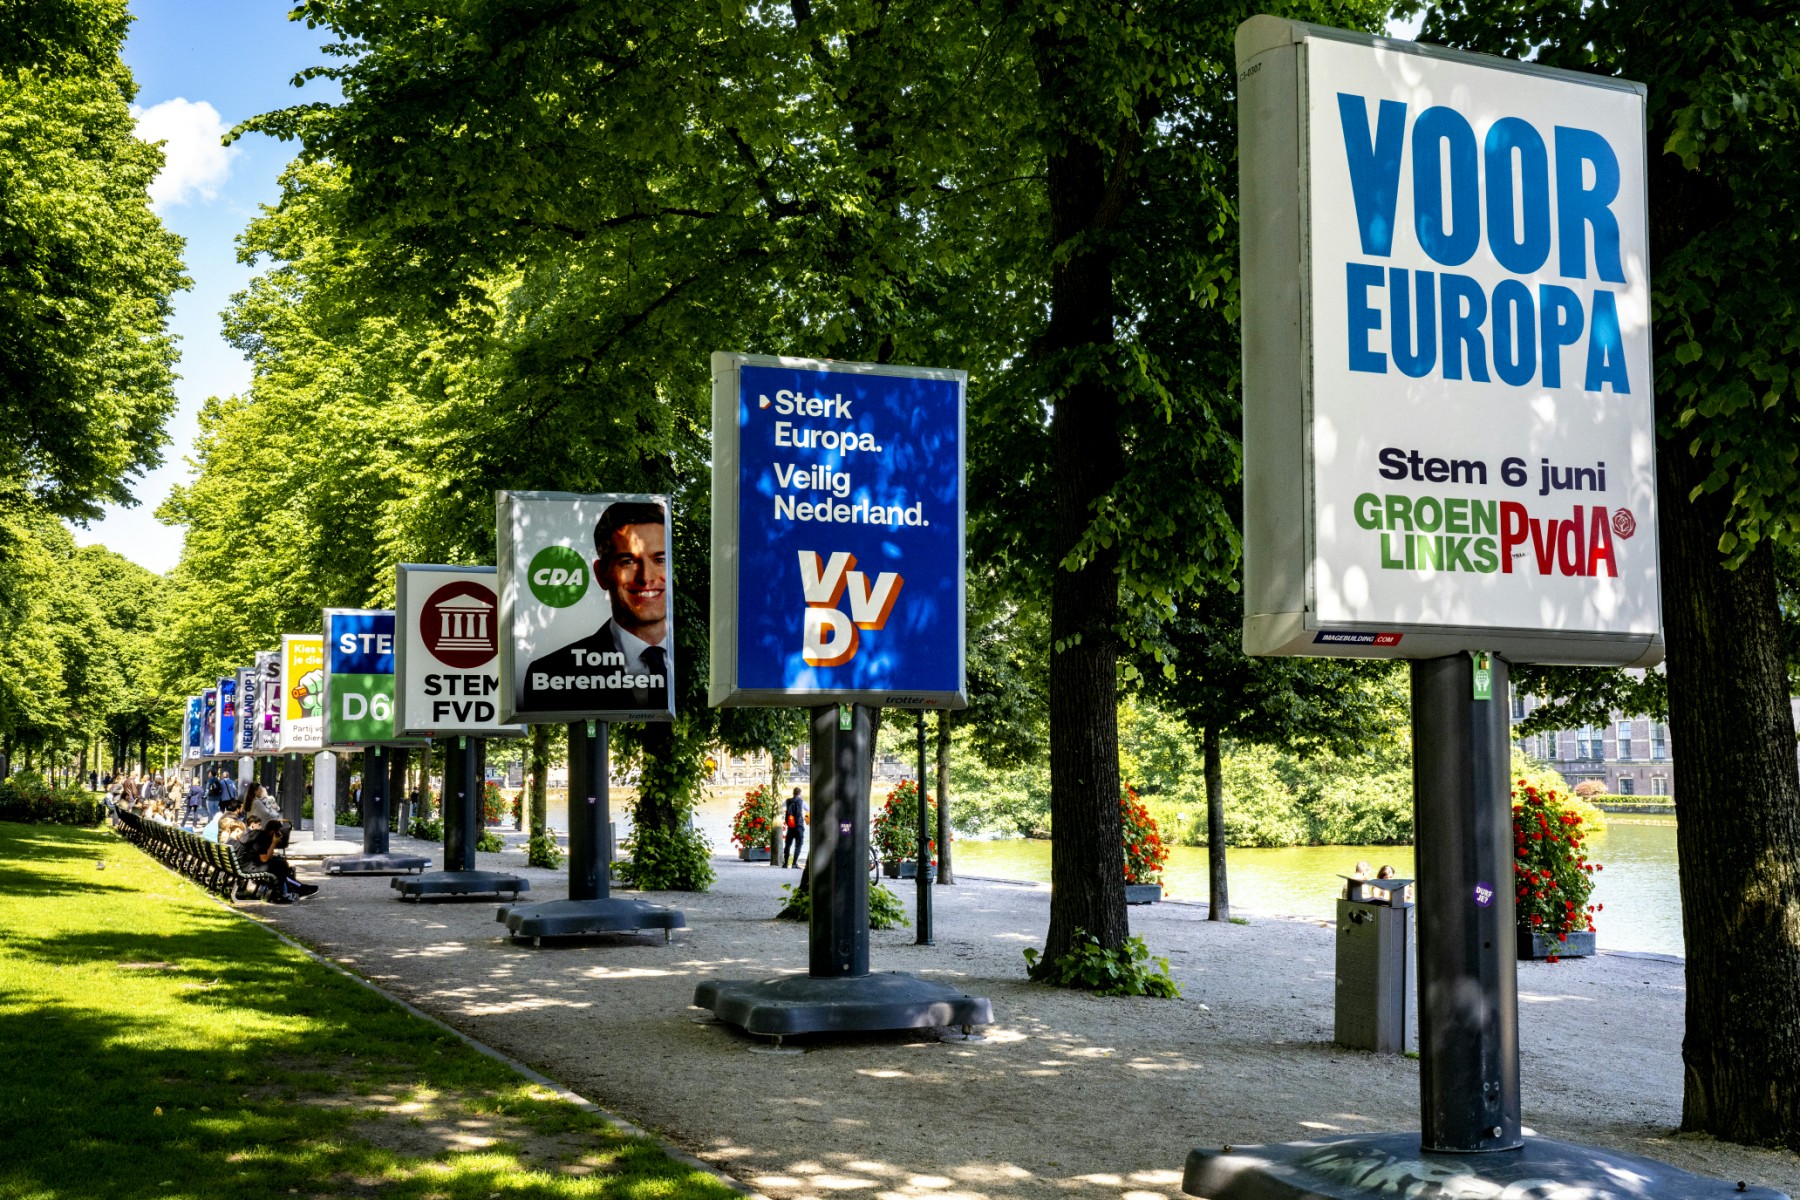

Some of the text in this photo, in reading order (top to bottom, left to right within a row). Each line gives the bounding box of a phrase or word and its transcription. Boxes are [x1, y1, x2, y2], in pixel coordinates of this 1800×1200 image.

[1336, 92, 1627, 284] VOOR
[1346, 261, 1631, 394] EUROPA
[775, 389, 853, 419] Sterk
[775, 421, 883, 457] Europa.
[773, 462, 851, 498] Veilig
[1378, 447, 1606, 496] Stem 6 juni
[774, 494, 929, 527] Nederland.
[1353, 492, 1498, 536] GROEN
[1380, 532, 1499, 574] LINKS
[1500, 500, 1619, 578] PvdA
[533, 568, 583, 586] CDA
[340, 633, 394, 655] STE
[571, 649, 626, 667] Tom
[532, 670, 666, 690] Berendsen
[243, 694, 255, 749] NEDERLAND
[342, 692, 395, 721] D6
[433, 701, 495, 723] FVD
